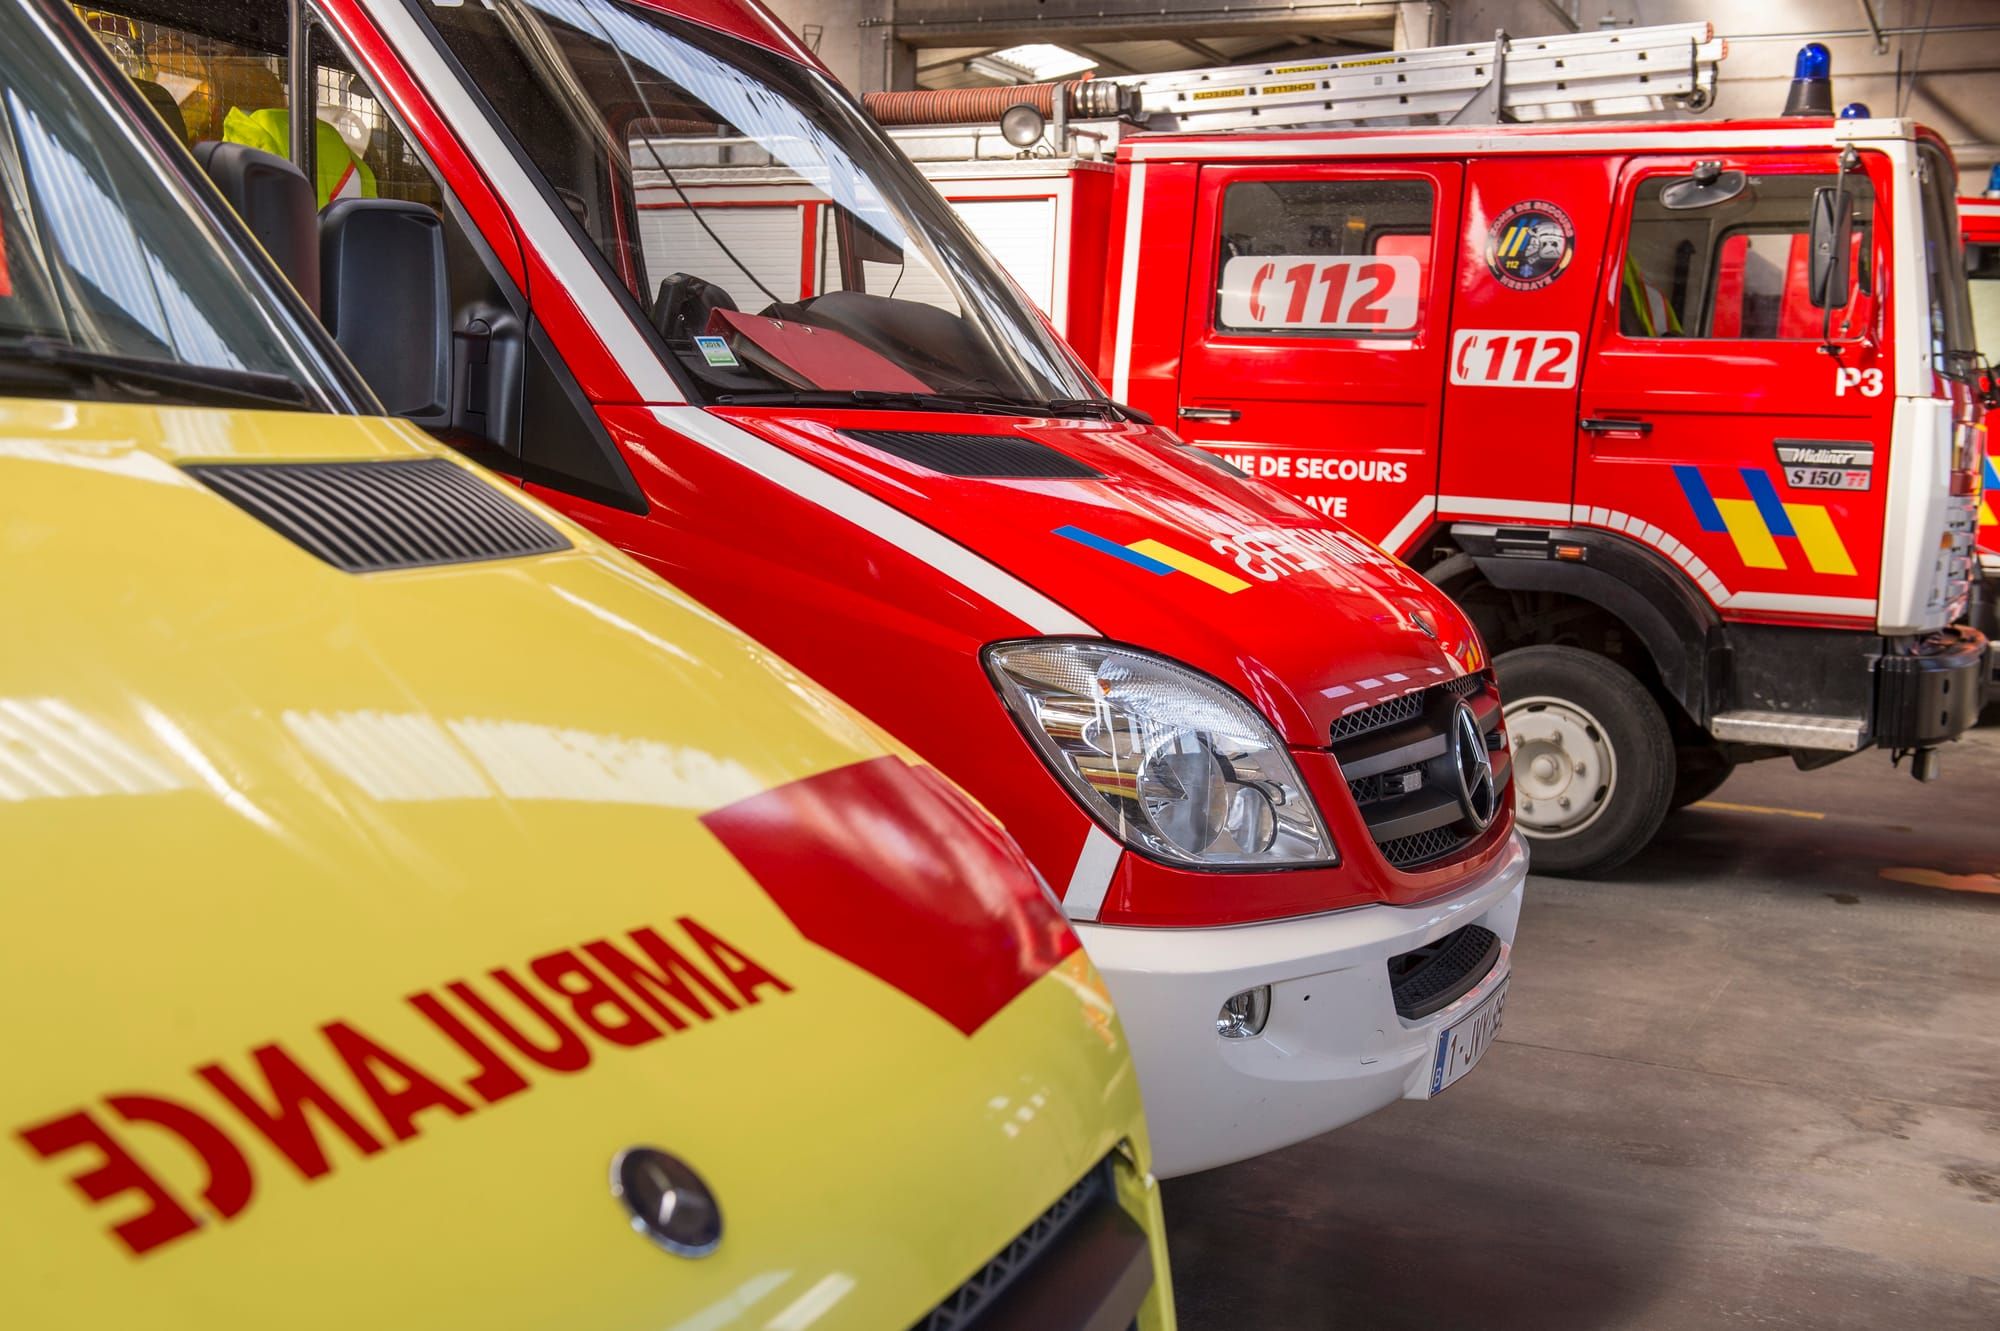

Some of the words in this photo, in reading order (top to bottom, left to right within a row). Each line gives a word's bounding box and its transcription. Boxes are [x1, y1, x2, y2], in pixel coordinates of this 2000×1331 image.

[1489, 208, 1514, 237] ZONE
[1515, 202, 1531, 212] DE
[1533, 201, 1574, 238] SECOURS
[1506, 261, 1519, 269] 112
[1285, 263, 1396, 323] 112
[1500, 275, 1552, 291] HESBAYE
[1485, 336, 1573, 383] 112
[1836, 367, 1883, 397] P3
[1792, 448, 1855, 465] Midliner
[1260, 457, 1291, 477] DE
[1296, 459, 1407, 483] SECOURS
[1791, 469, 1805, 485] S
[1809, 470, 1842, 487] 150
[1433, 1067, 1442, 1085] B
